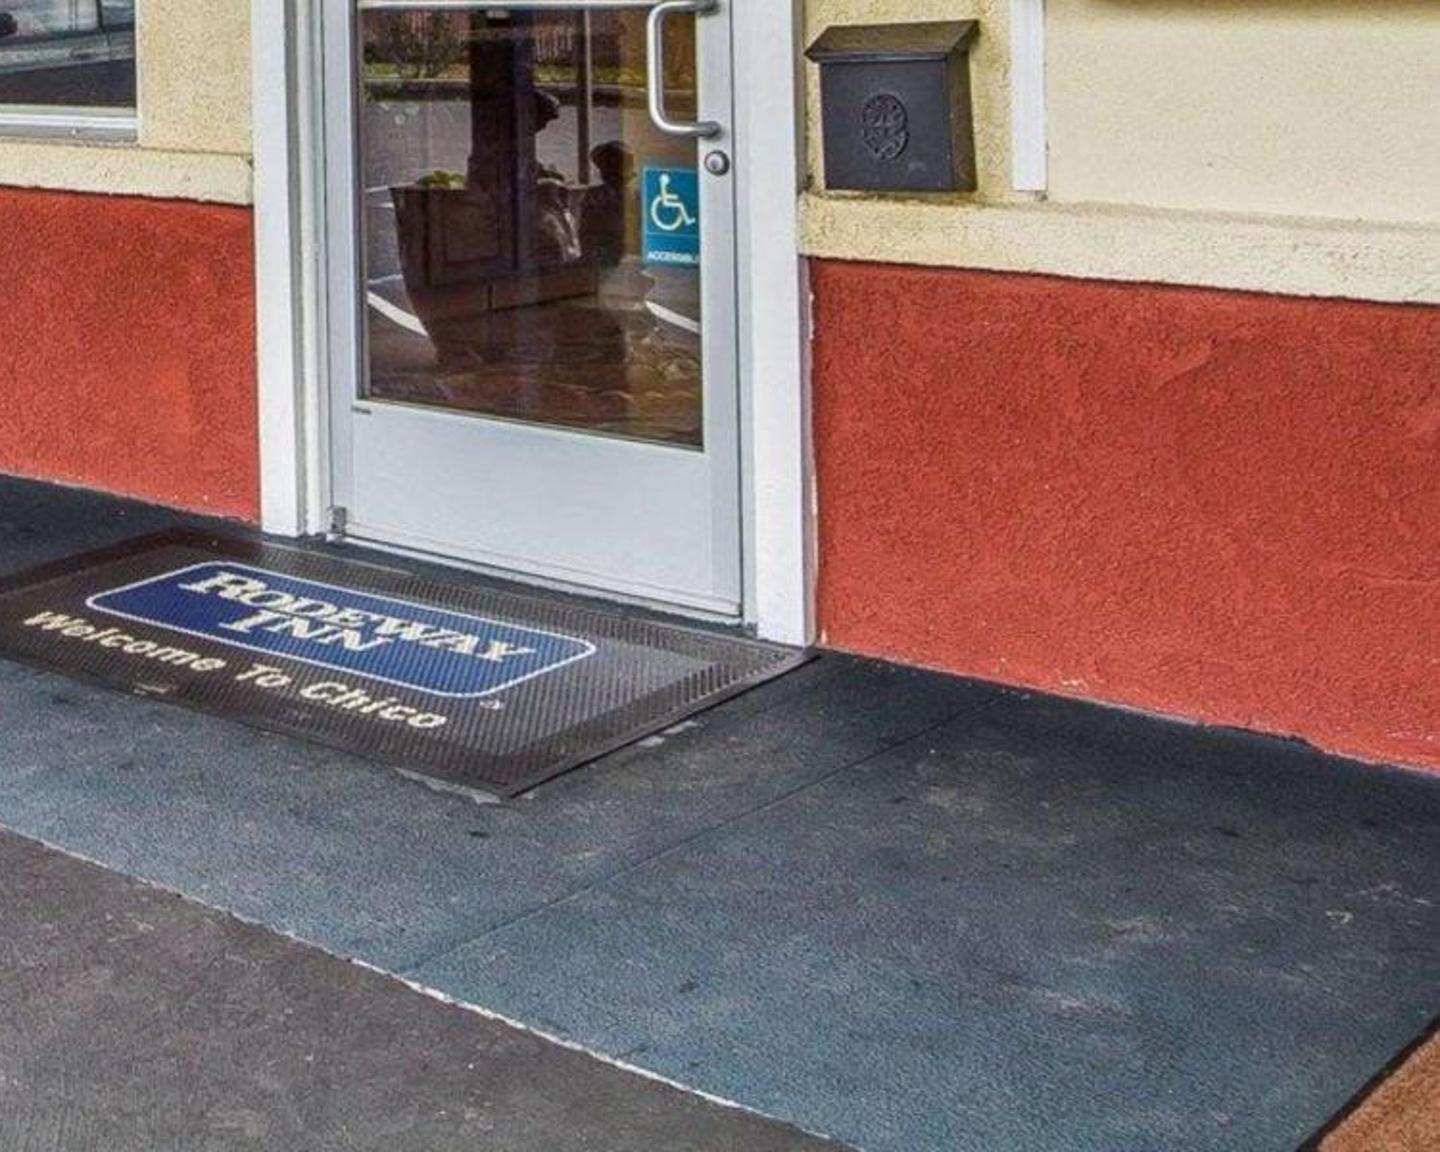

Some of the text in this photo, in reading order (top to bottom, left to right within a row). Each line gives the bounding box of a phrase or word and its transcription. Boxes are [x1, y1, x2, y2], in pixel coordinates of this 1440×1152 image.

[178, 571, 537, 663] RODEWAY
[219, 608, 394, 651] INN
[23, 610, 447, 728] Welcome To Chico
